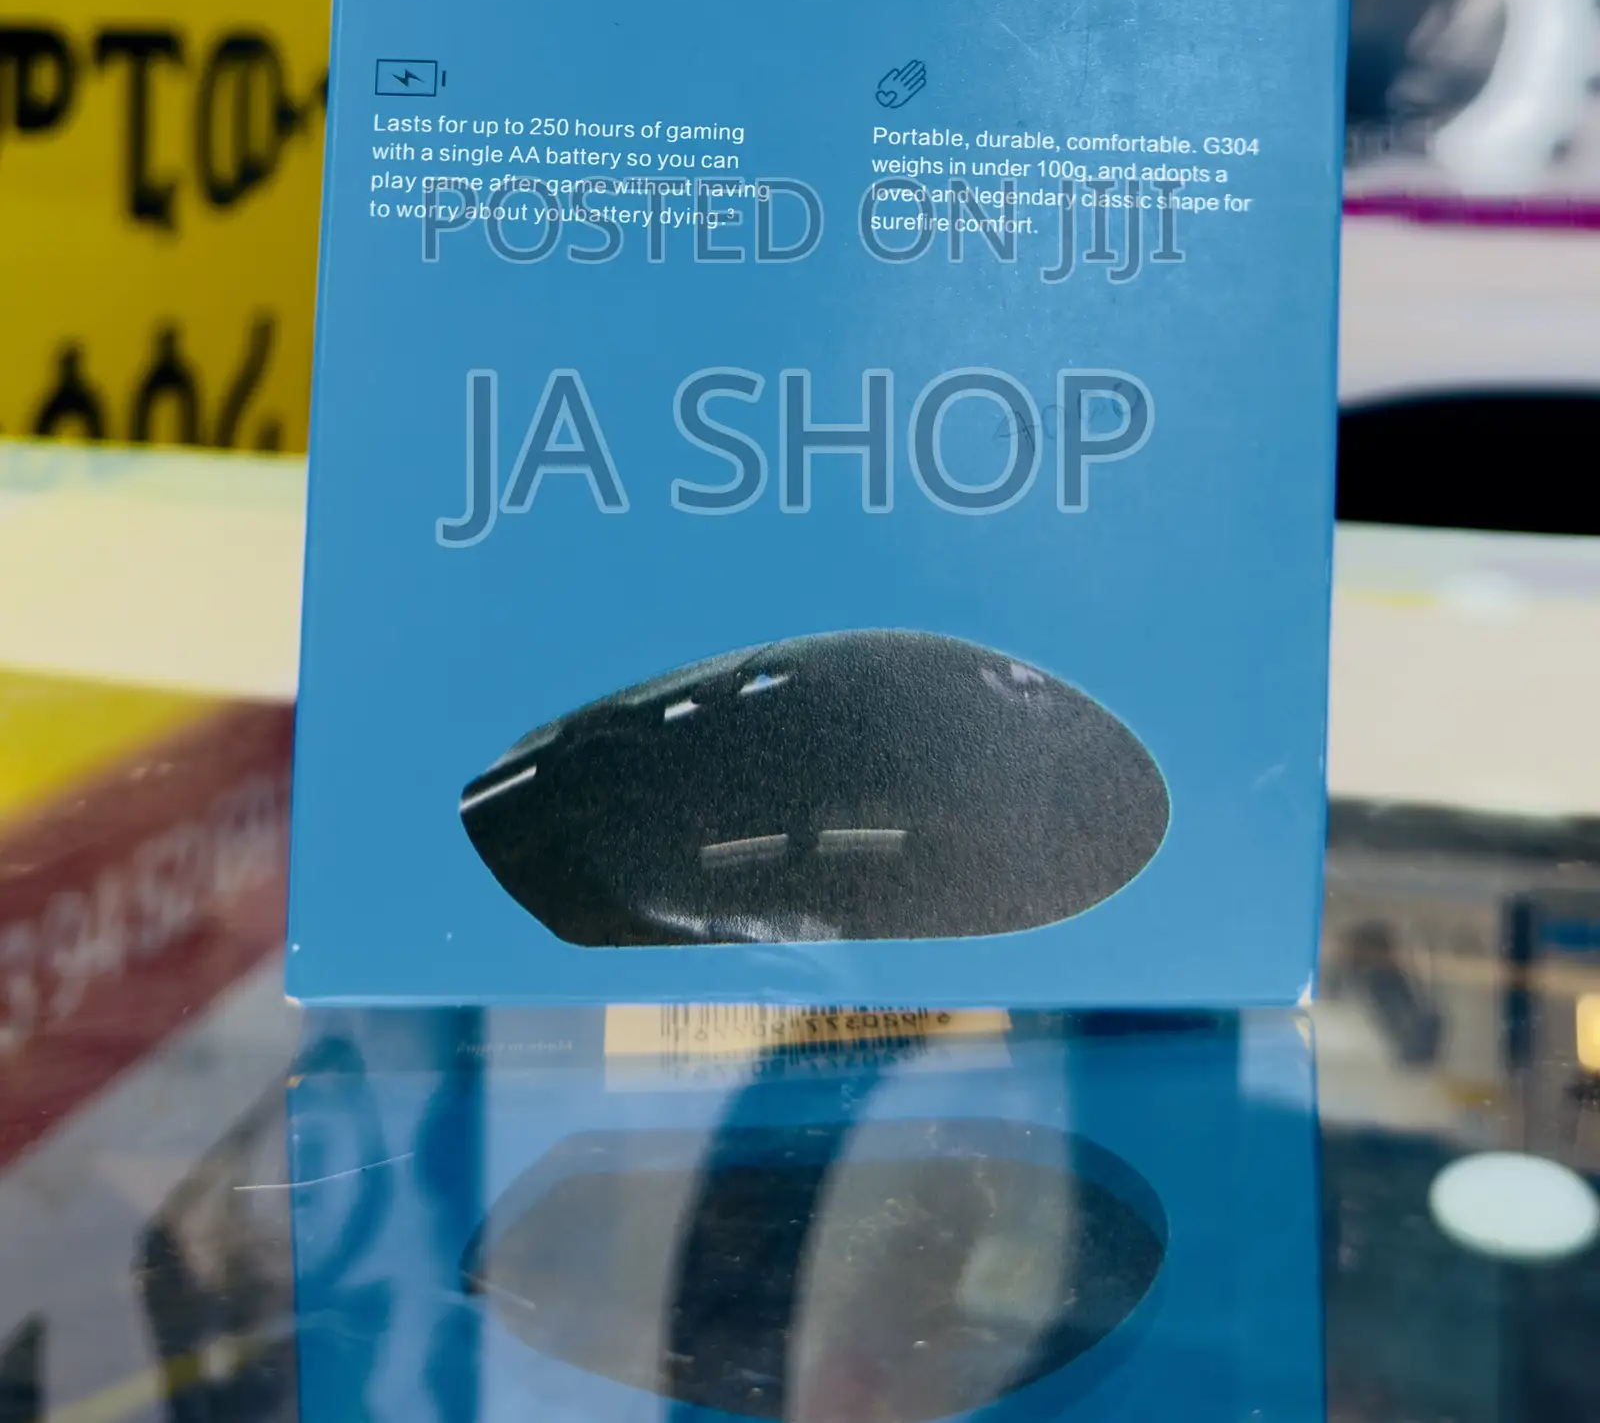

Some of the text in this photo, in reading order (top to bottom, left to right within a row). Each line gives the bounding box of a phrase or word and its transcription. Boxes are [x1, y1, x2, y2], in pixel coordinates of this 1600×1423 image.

[373, 113, 745, 145] Lasts for up to 250 hours of gaming
[873, 126, 1260, 156] Portable, durable, comfortable. G304
[372, 142, 739, 171] with a single AA battery so you can
[871, 156, 1228, 187] weighs in under 100g, and adopts a
[371, 171, 771, 202] play game after game without having
[871, 182, 1253, 214] loved and legendary classic shape for
[369, 200, 391, 218] to
[396, 204, 459, 223] worry
[464, 202, 528, 223] about
[870, 212, 1038, 234] surefire comfort.
